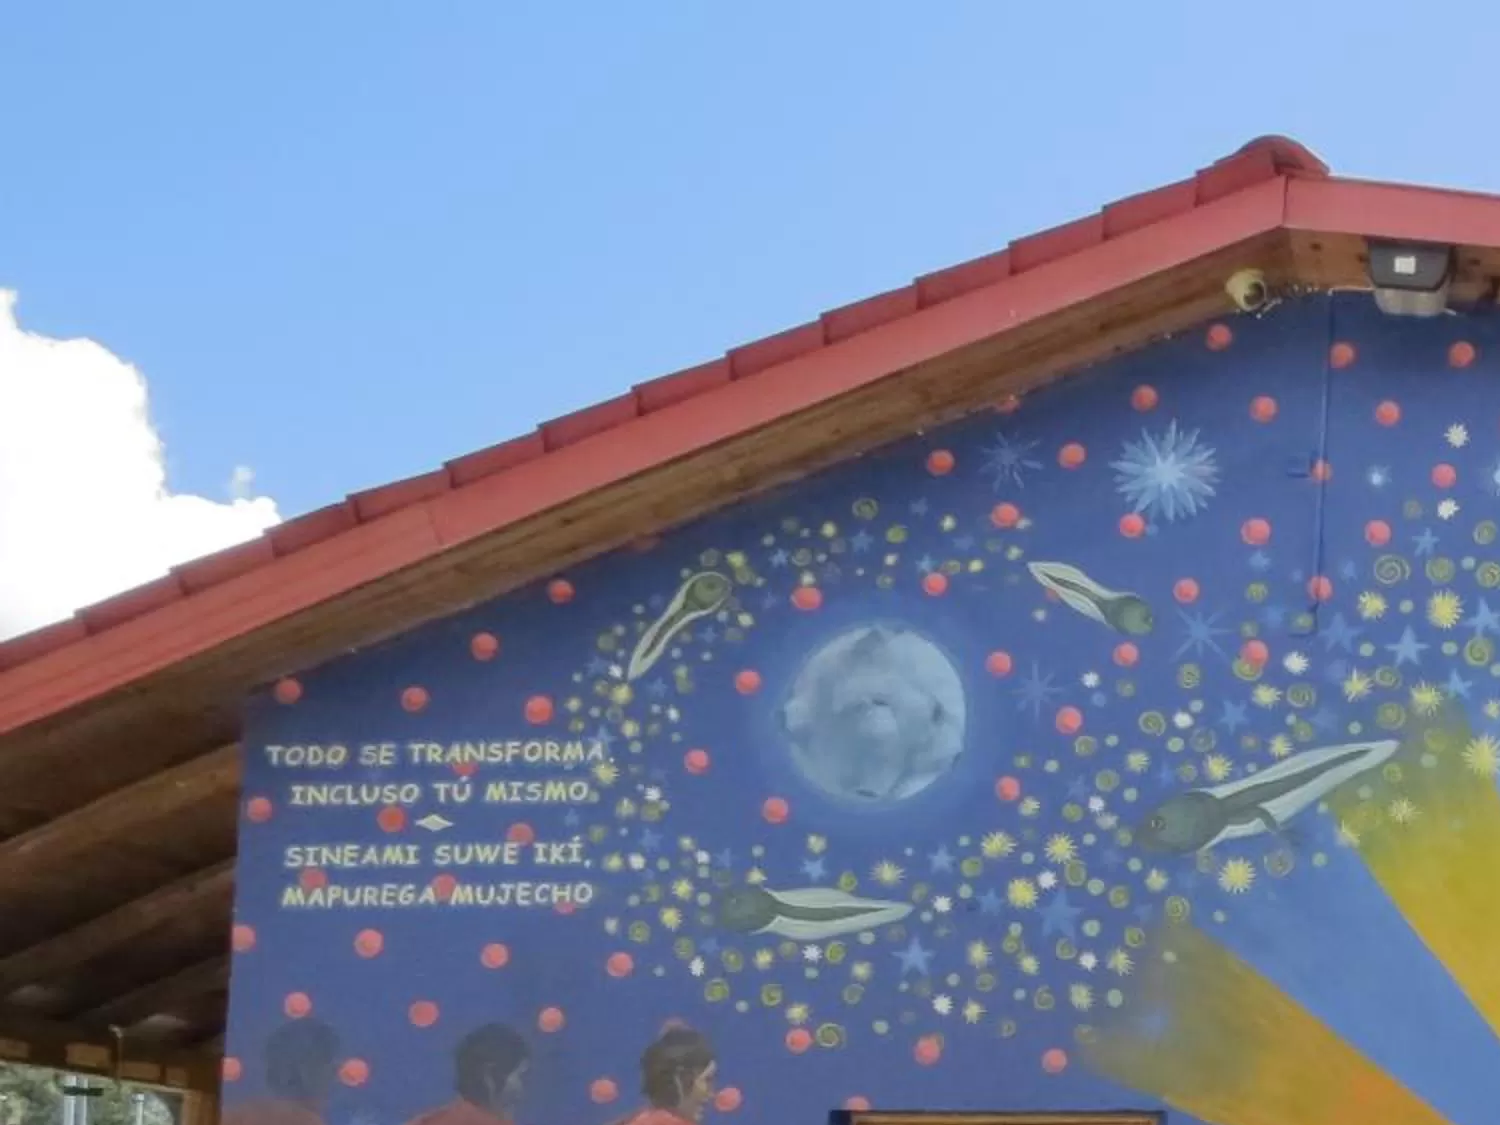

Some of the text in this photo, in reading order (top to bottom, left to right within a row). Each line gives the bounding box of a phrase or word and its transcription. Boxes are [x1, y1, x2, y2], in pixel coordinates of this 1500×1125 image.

[265, 744, 347, 766] TODO
[360, 743, 397, 766] SE
[290, 776, 588, 806] INCLUSO TÚ MISMO
[284, 845, 420, 867] SINEAMI
[433, 843, 519, 865] SUWE
[282, 882, 593, 908] MAPUREGA MUJECHO
